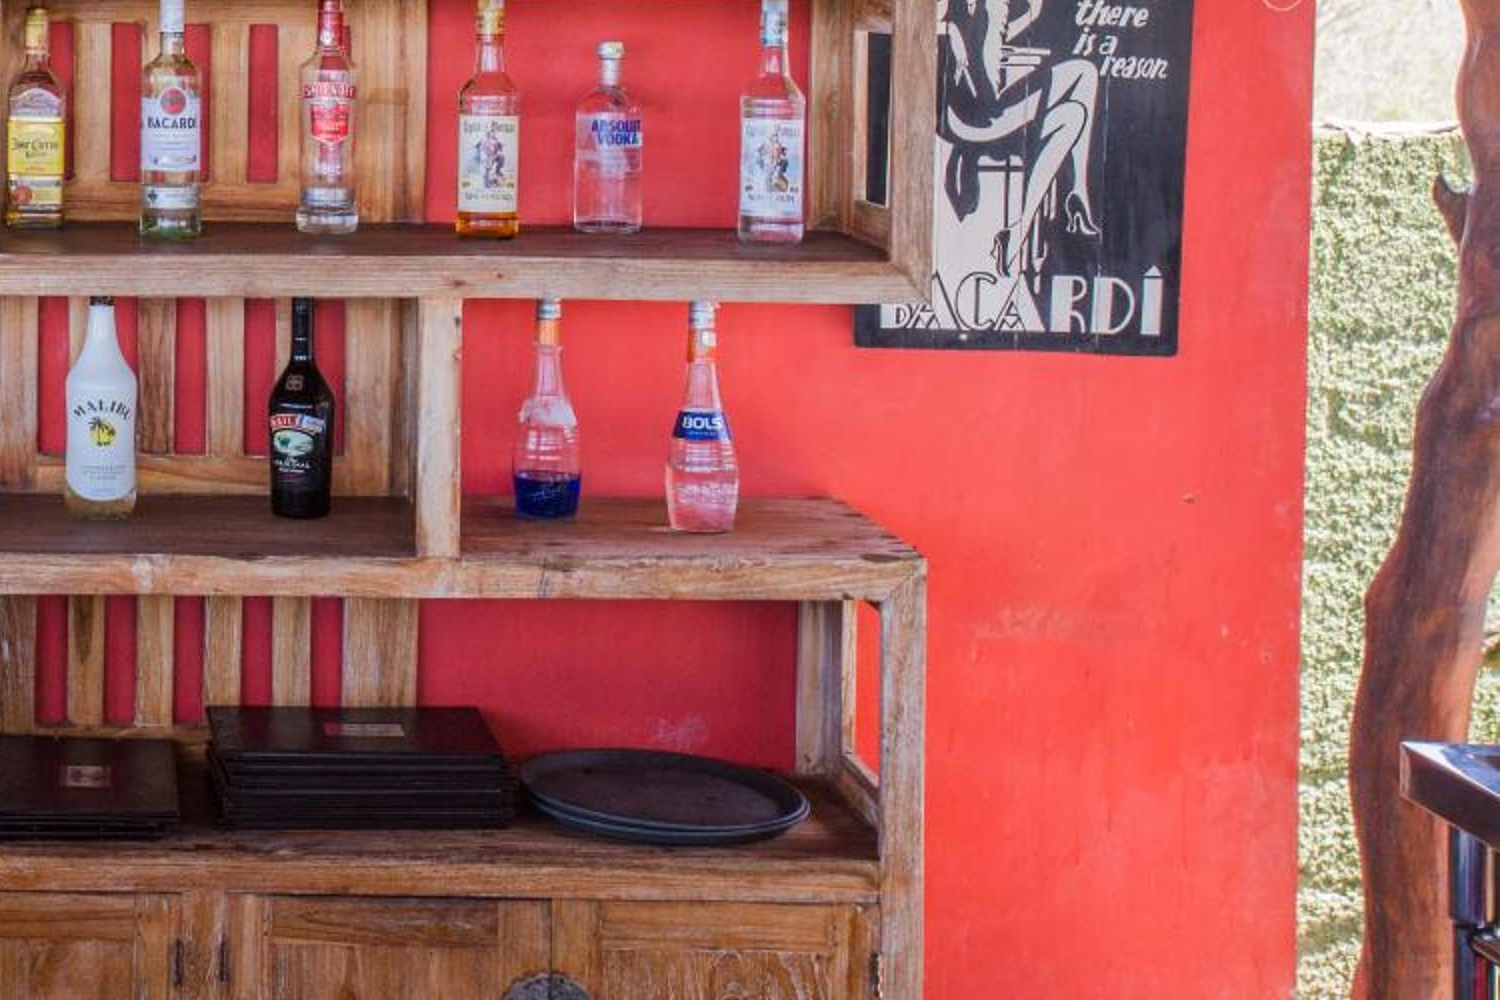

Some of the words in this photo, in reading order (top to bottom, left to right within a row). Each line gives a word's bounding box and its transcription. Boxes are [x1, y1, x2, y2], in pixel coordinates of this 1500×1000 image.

[1072, 27, 1097, 56] is
[1099, 35, 1118, 55] a
[1100, 55, 1169, 79] reason
[681, 416, 723, 430] BOLS
